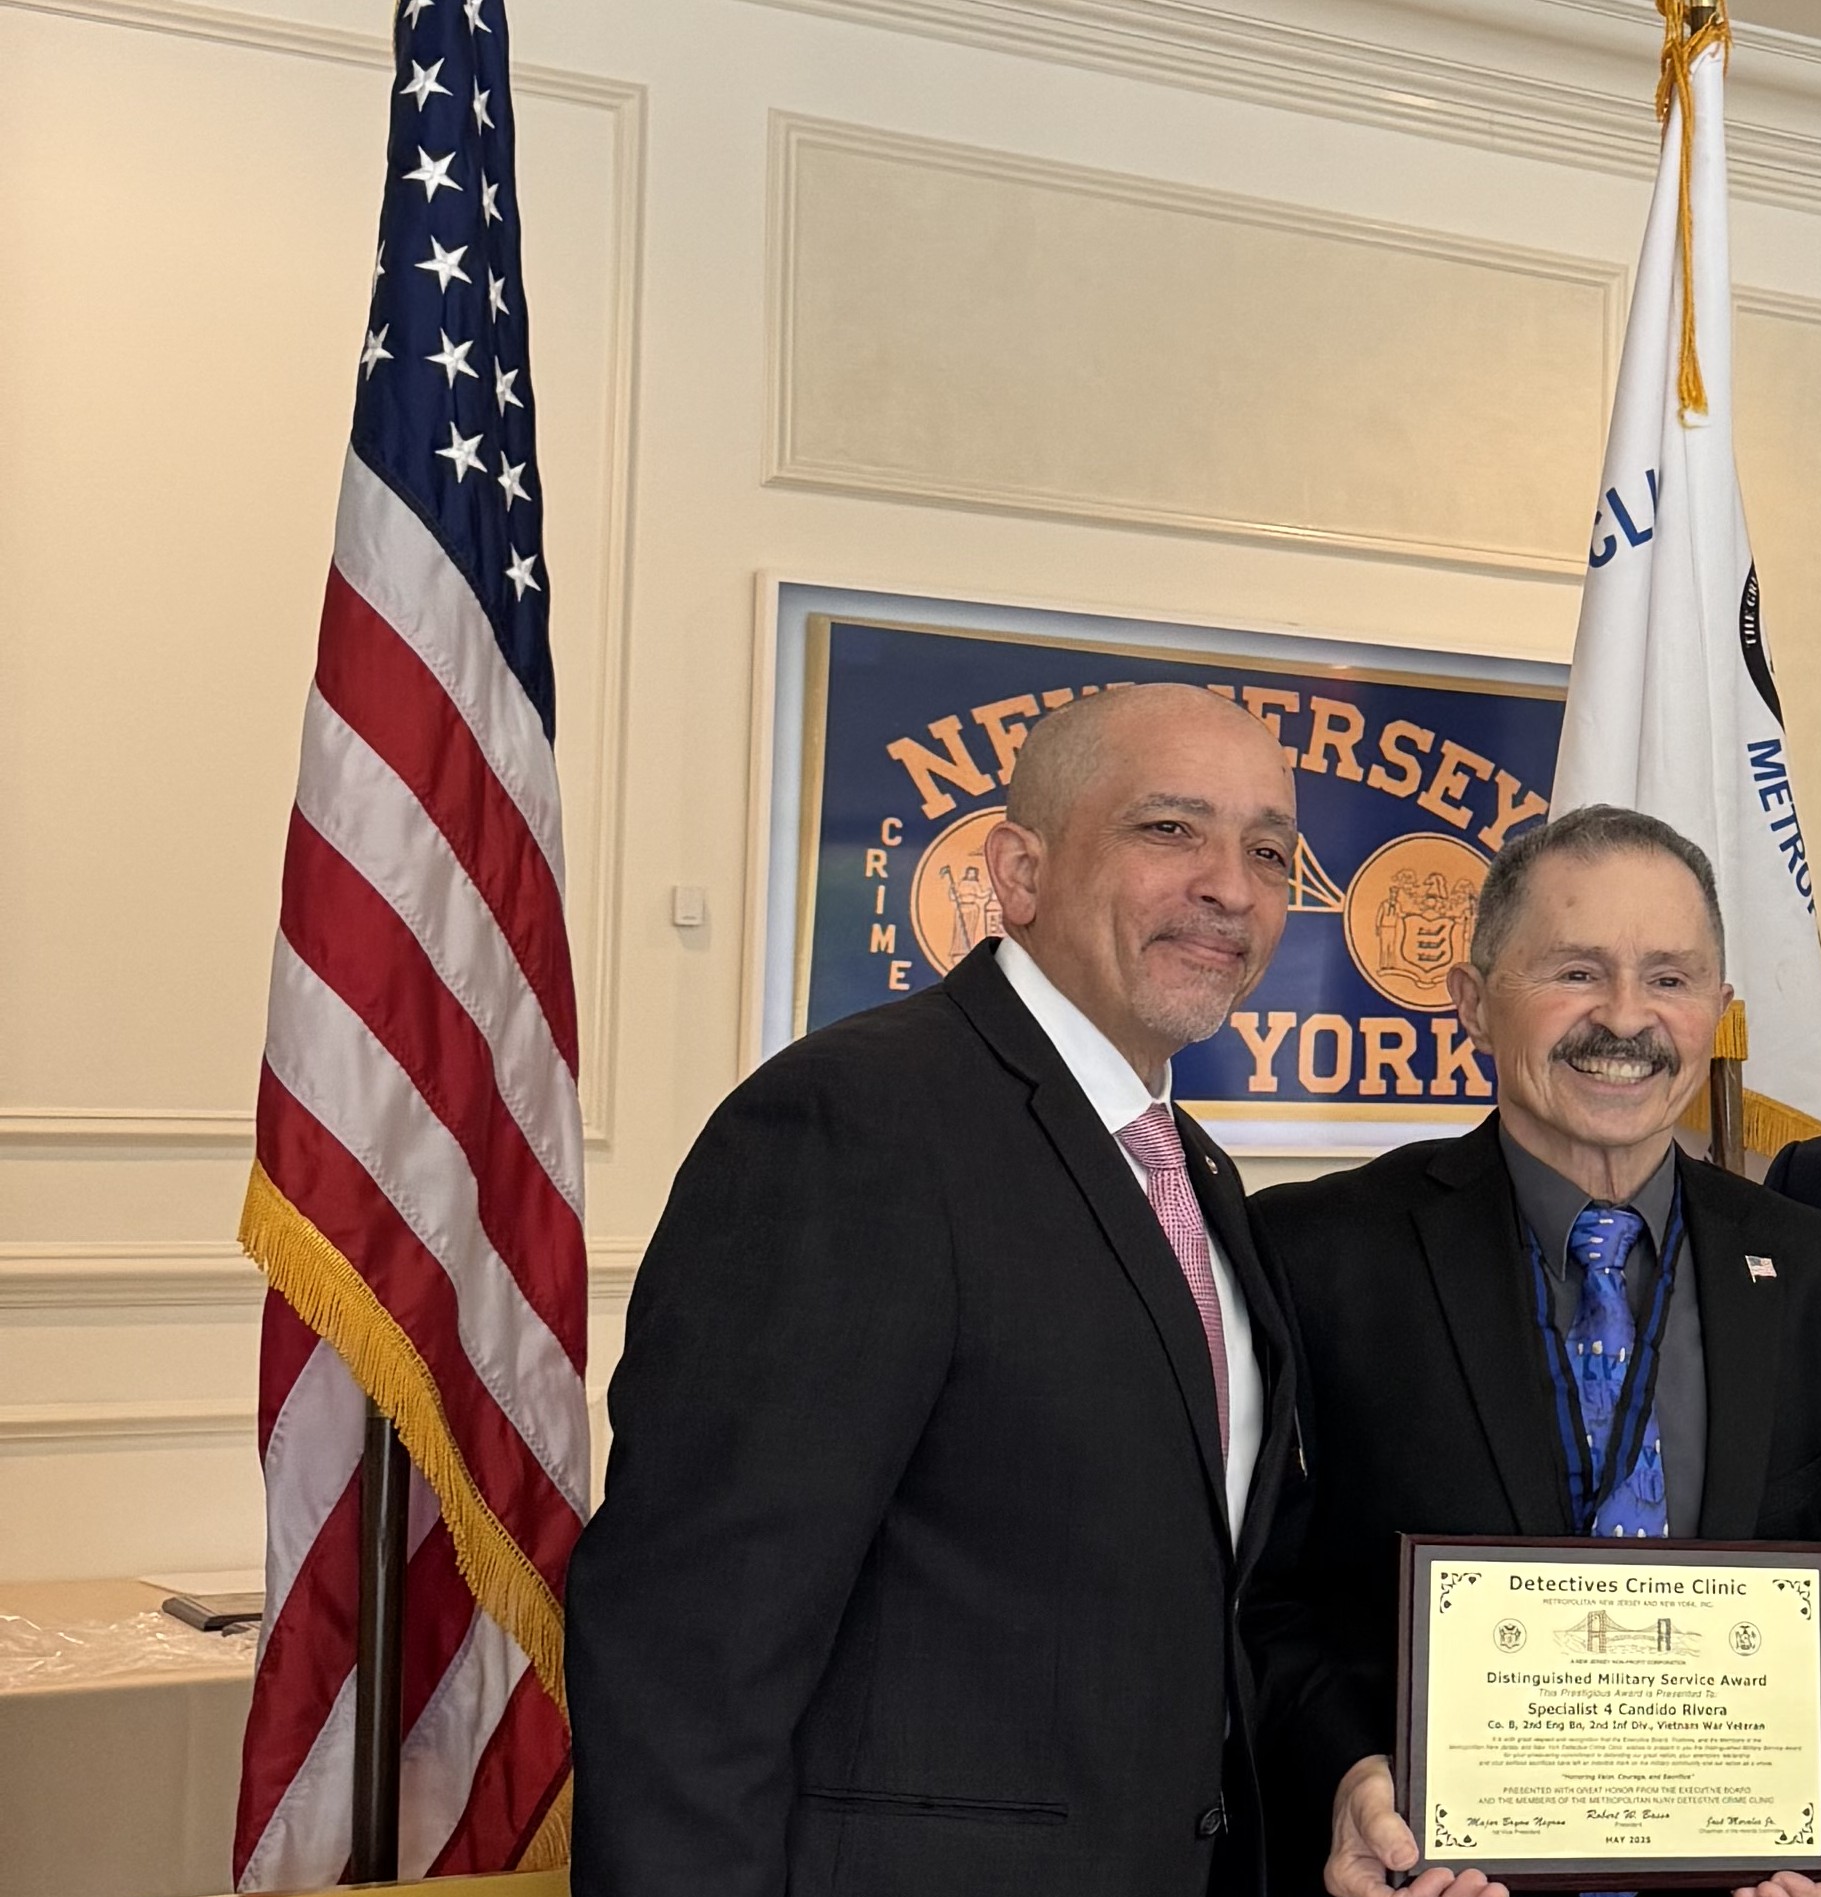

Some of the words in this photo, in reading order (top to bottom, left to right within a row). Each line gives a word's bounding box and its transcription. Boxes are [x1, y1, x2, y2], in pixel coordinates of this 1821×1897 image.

[1207, 683, 1549, 853] ERSEY
[865, 817, 912, 991] CRIME
[1230, 1011, 1493, 1097] YORK
[1510, 1575, 1617, 1592] Detectives
[1626, 1577, 1684, 1593] Crime
[1692, 1578, 1746, 1595] Clinic
[1487, 1671, 1591, 1686] Distinguished
[1598, 1673, 1655, 1687] Military
[1661, 1673, 1714, 1685] Service
[1720, 1674, 1766, 1686] Award
[1528, 1702, 1598, 1717] Specialist
[1604, 1703, 1612, 1715] 4
[1618, 1703, 1676, 1715] Candido
[1682, 1703, 1727, 1715] Rivera
[1508, 1720, 1518, 1730] B,
[1523, 1720, 1541, 1729] 2nd
[1546, 1720, 1564, 1731] Eng
[1589, 1720, 1608, 1729] 2nd
[1613, 1720, 1627, 1729] Inf
[1657, 1721, 1698, 1730] Vietnam
[1702, 1721, 1722, 1730] War
[1726, 1721, 1765, 1730] Veteran
[1466, 1817, 1498, 1828] Major
